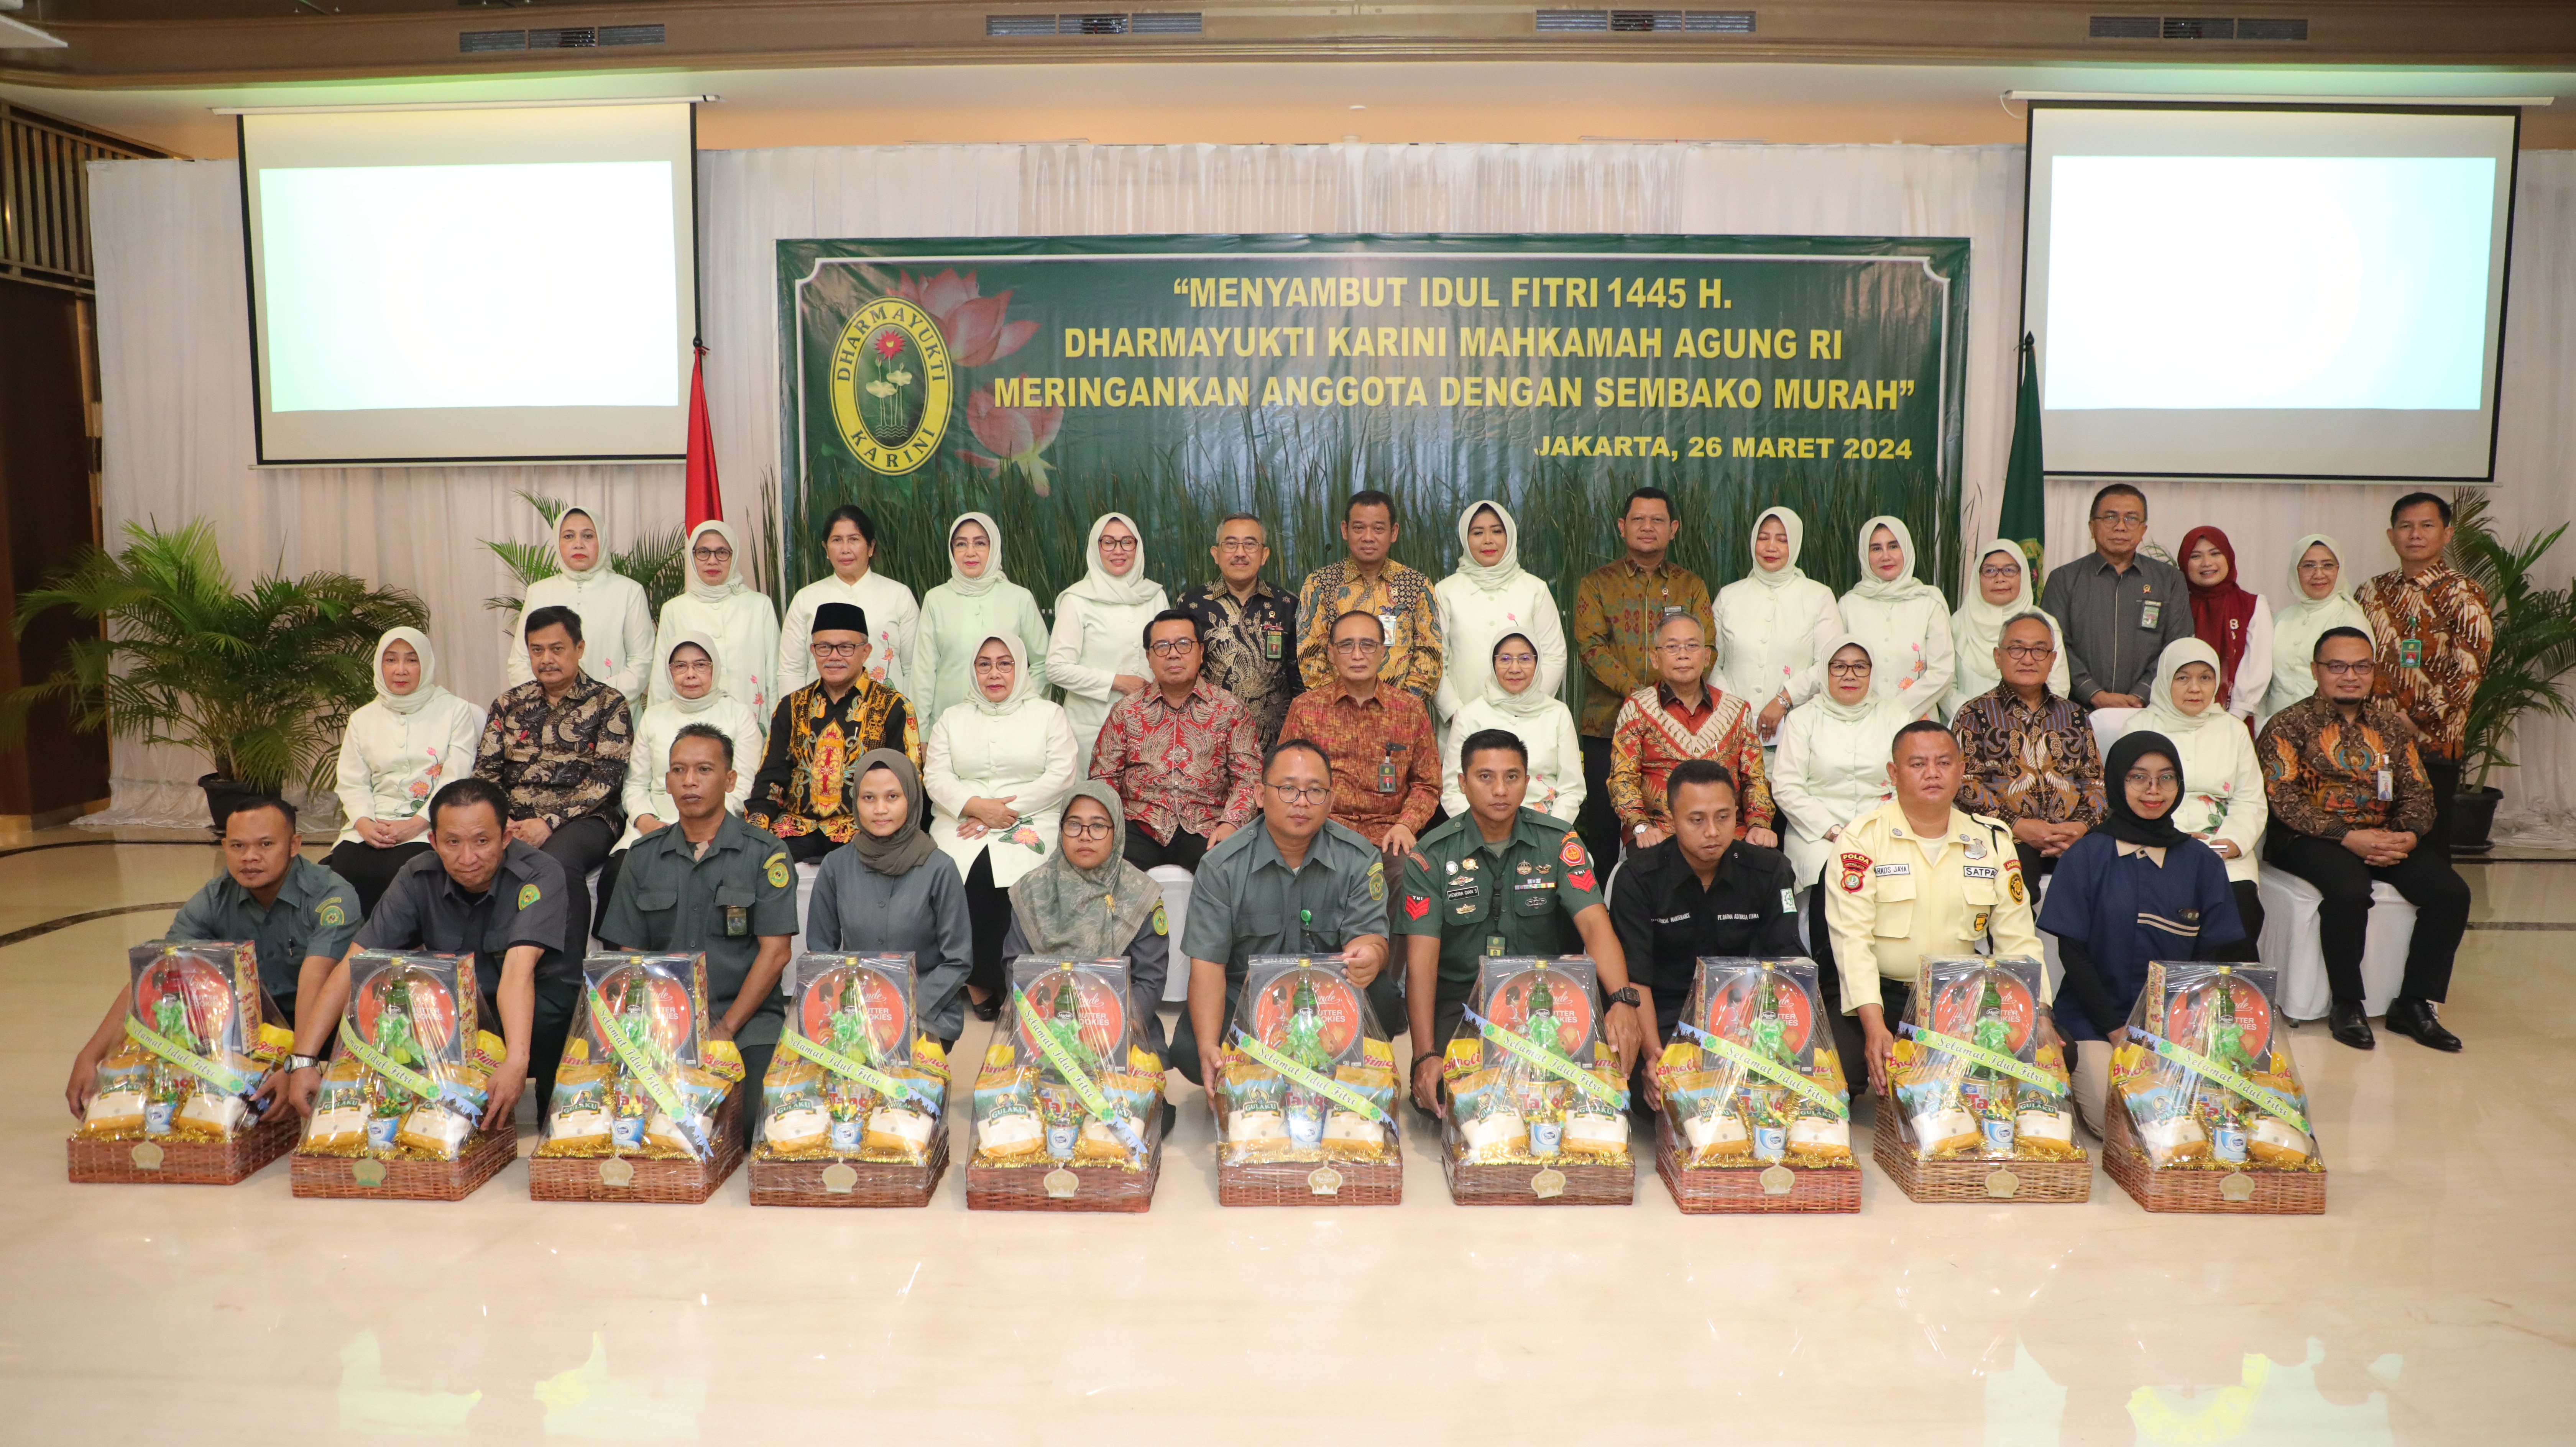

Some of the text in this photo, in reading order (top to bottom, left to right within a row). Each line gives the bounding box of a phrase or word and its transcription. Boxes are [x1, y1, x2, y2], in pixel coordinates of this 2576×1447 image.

[1174, 277, 1732, 308] “MENYAMBUT IDUL FITRI 1445 H.
[837, 305, 945, 382] DHARMAYUKTI
[1065, 326, 1842, 359] DHARMAYUKTI KARINI MAHKAMAH AGUNG RI
[994, 376, 1914, 410] MERINGANKAN ANGGOTA DENGAN SEMBAKO MURAH”
[850, 427, 935, 468] KARINI
[1535, 435, 1912, 461] JAKARTA, 26 MARET 2024
[1843, 854, 1870, 865] POLDA
[164, 1045, 191, 1063] Idul
[191, 1059, 218, 1077] Fitri
[365, 1050, 386, 1070] Idul
[388, 1066, 414, 1084] Fitri
[599, 1009, 666, 1097] Selamat Idul Fitri
[789, 1035, 882, 1086] Selamat Idul Fitri
[1025, 1010, 1095, 1098] Selamat Idul Fitri
[1444, 1051, 1481, 1074] Bimoli
[1503, 1035, 1602, 1092] Selamat Idul Fitri
[1938, 1037, 2044, 1082] Selamat Idul Fitri
[1258, 1047, 1357, 1105] Selamat Idul Fitri
[1727, 1046, 1828, 1104] Selamat Idul Fitri
[2184, 1053, 2232, 1083] Selamat
[2235, 1079, 2263, 1100] Idul
[2264, 1096, 2287, 1116] Fitri
[777, 1101, 810, 1114] GULAKU
[991, 1106, 1025, 1119] GULAKU
[1245, 1102, 1276, 1111] GULAKU
[1579, 1107, 1613, 1115] GULAKU
[1800, 1111, 1835, 1120] GULAKU
[2019, 1102, 2054, 1113] GULAKU
